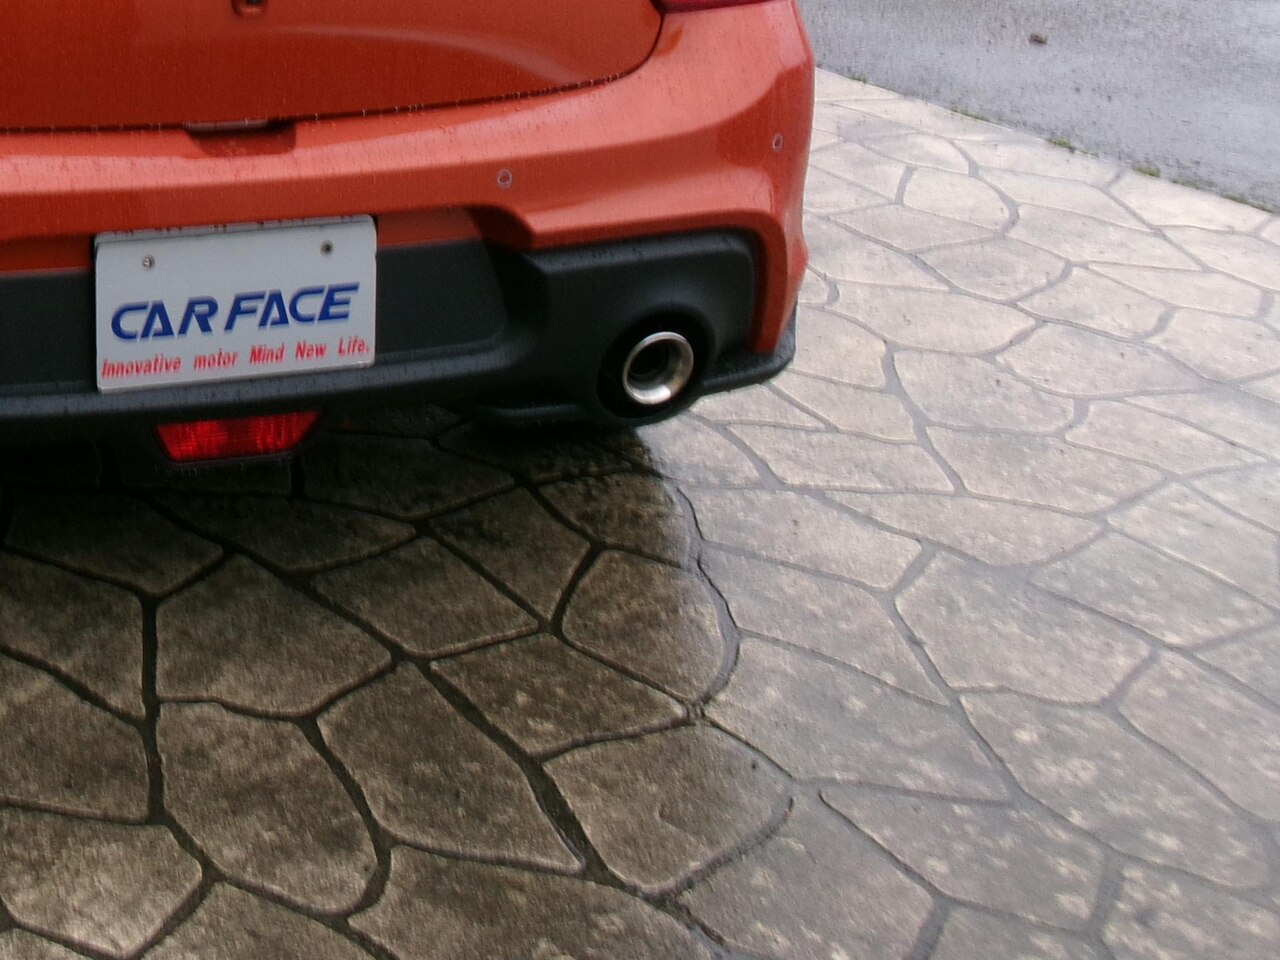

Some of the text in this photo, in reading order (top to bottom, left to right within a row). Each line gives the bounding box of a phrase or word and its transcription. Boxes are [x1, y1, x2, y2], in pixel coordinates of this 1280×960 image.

[101, 335, 370, 378] Innovative motor Mind New Life.
